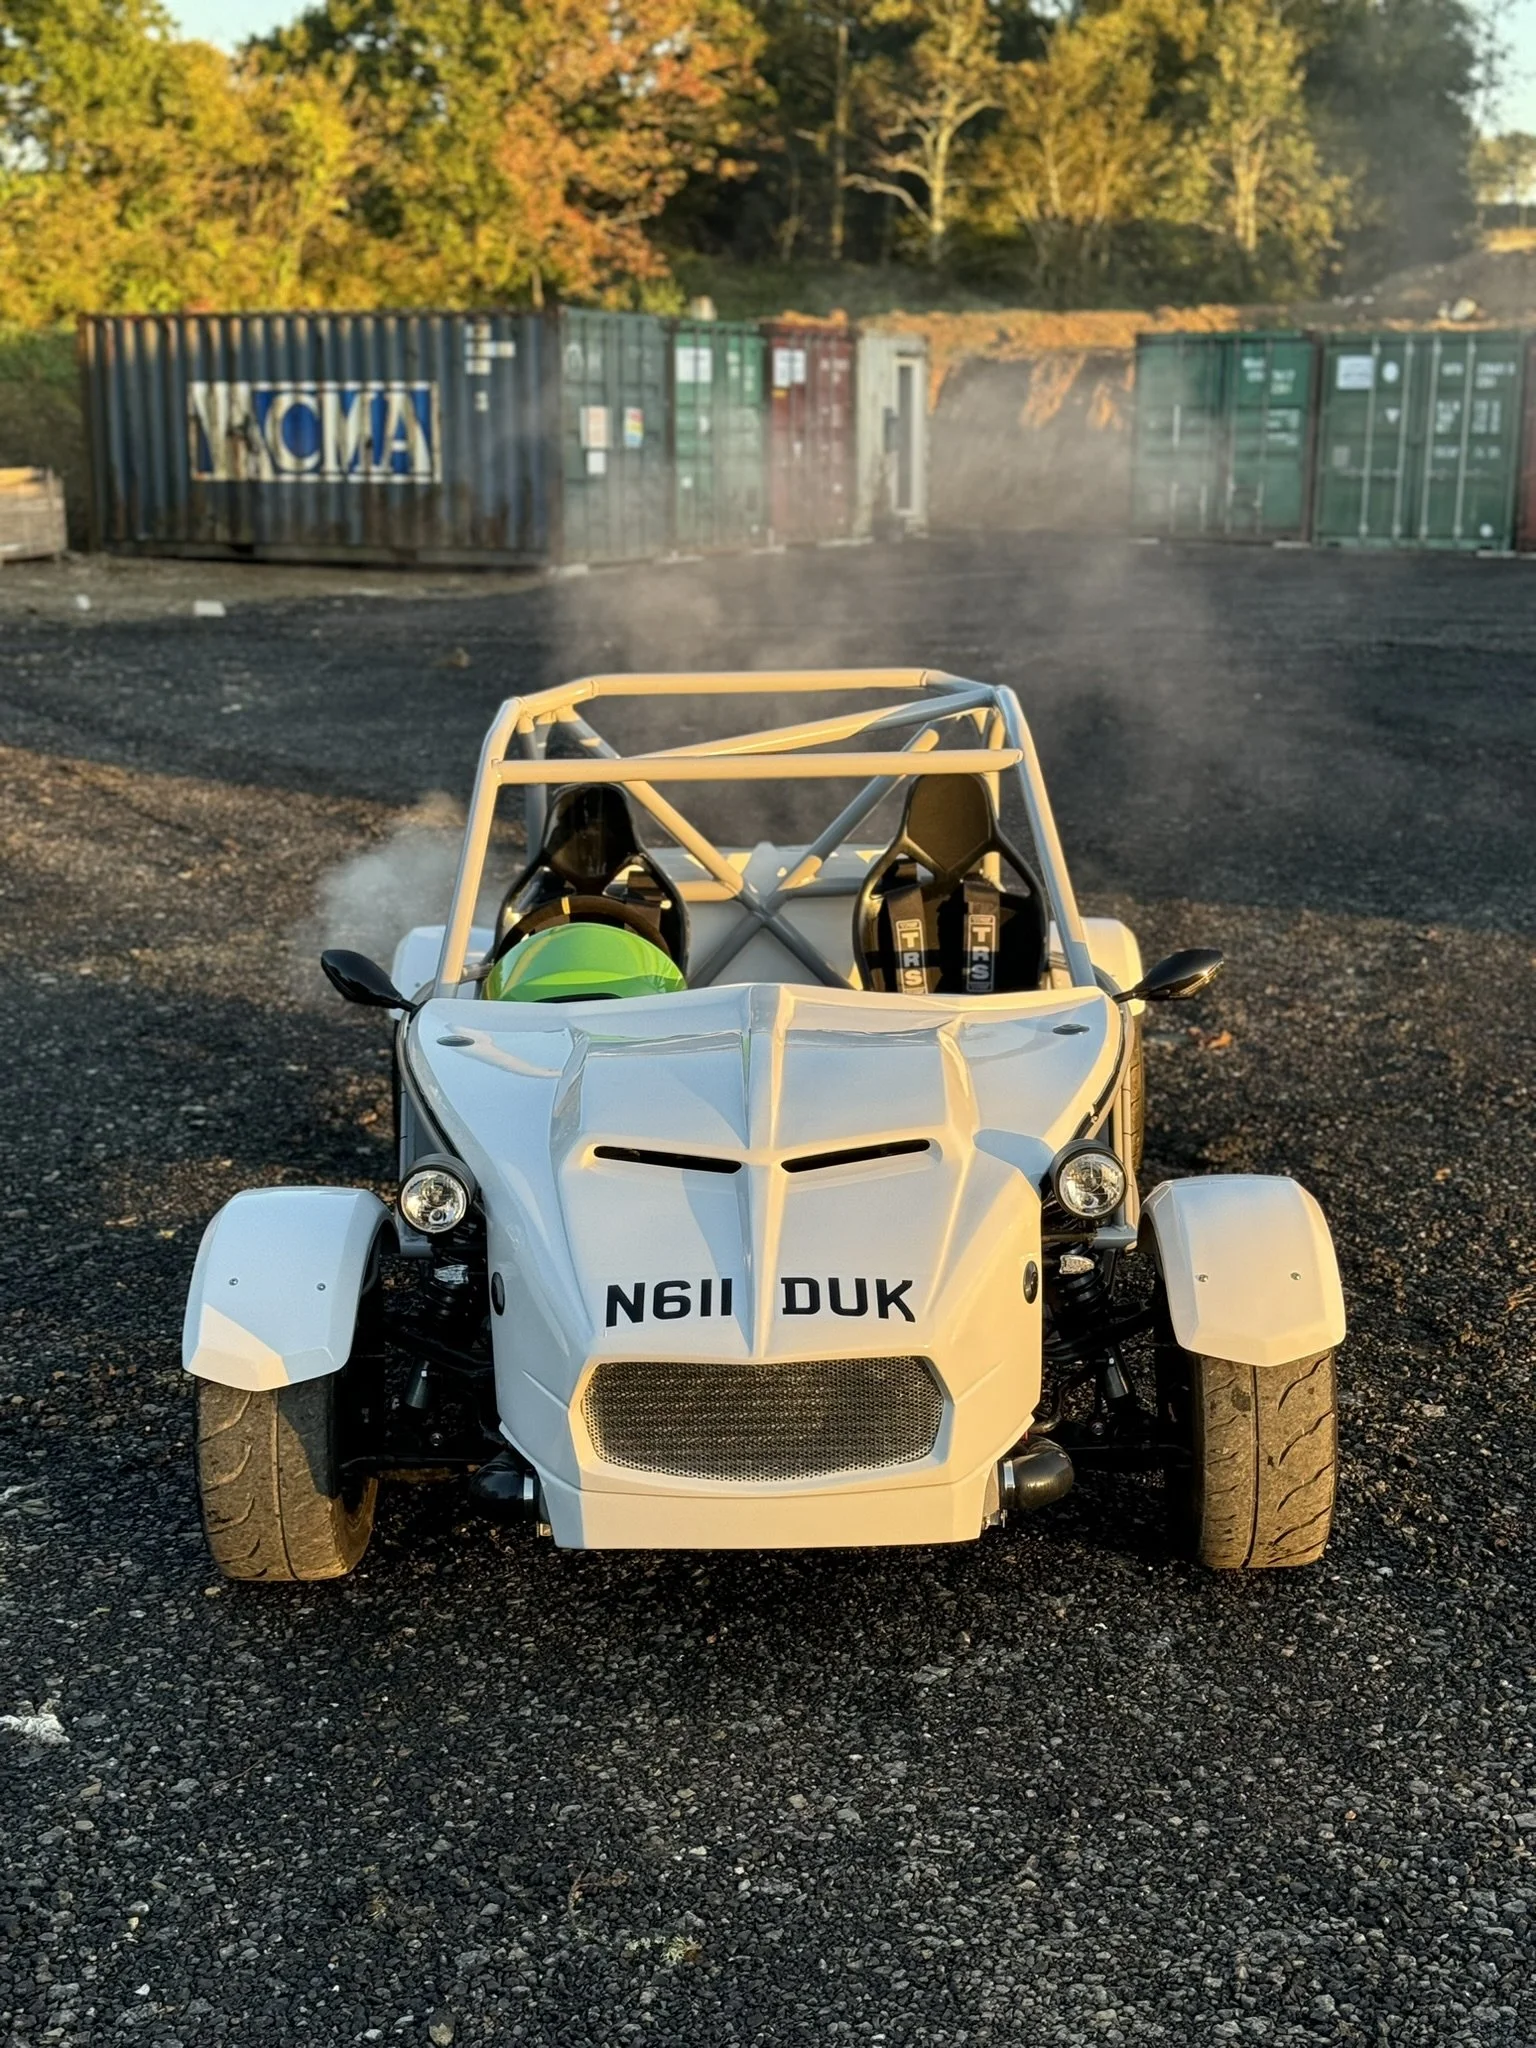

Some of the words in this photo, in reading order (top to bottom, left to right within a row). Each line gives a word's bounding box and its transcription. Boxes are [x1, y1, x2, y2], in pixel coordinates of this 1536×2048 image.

[901, 931, 923, 986] TRS
[971, 926, 991, 980] TRS
[605, 1277, 733, 1327] N611
[780, 1276, 916, 1323] DUK
